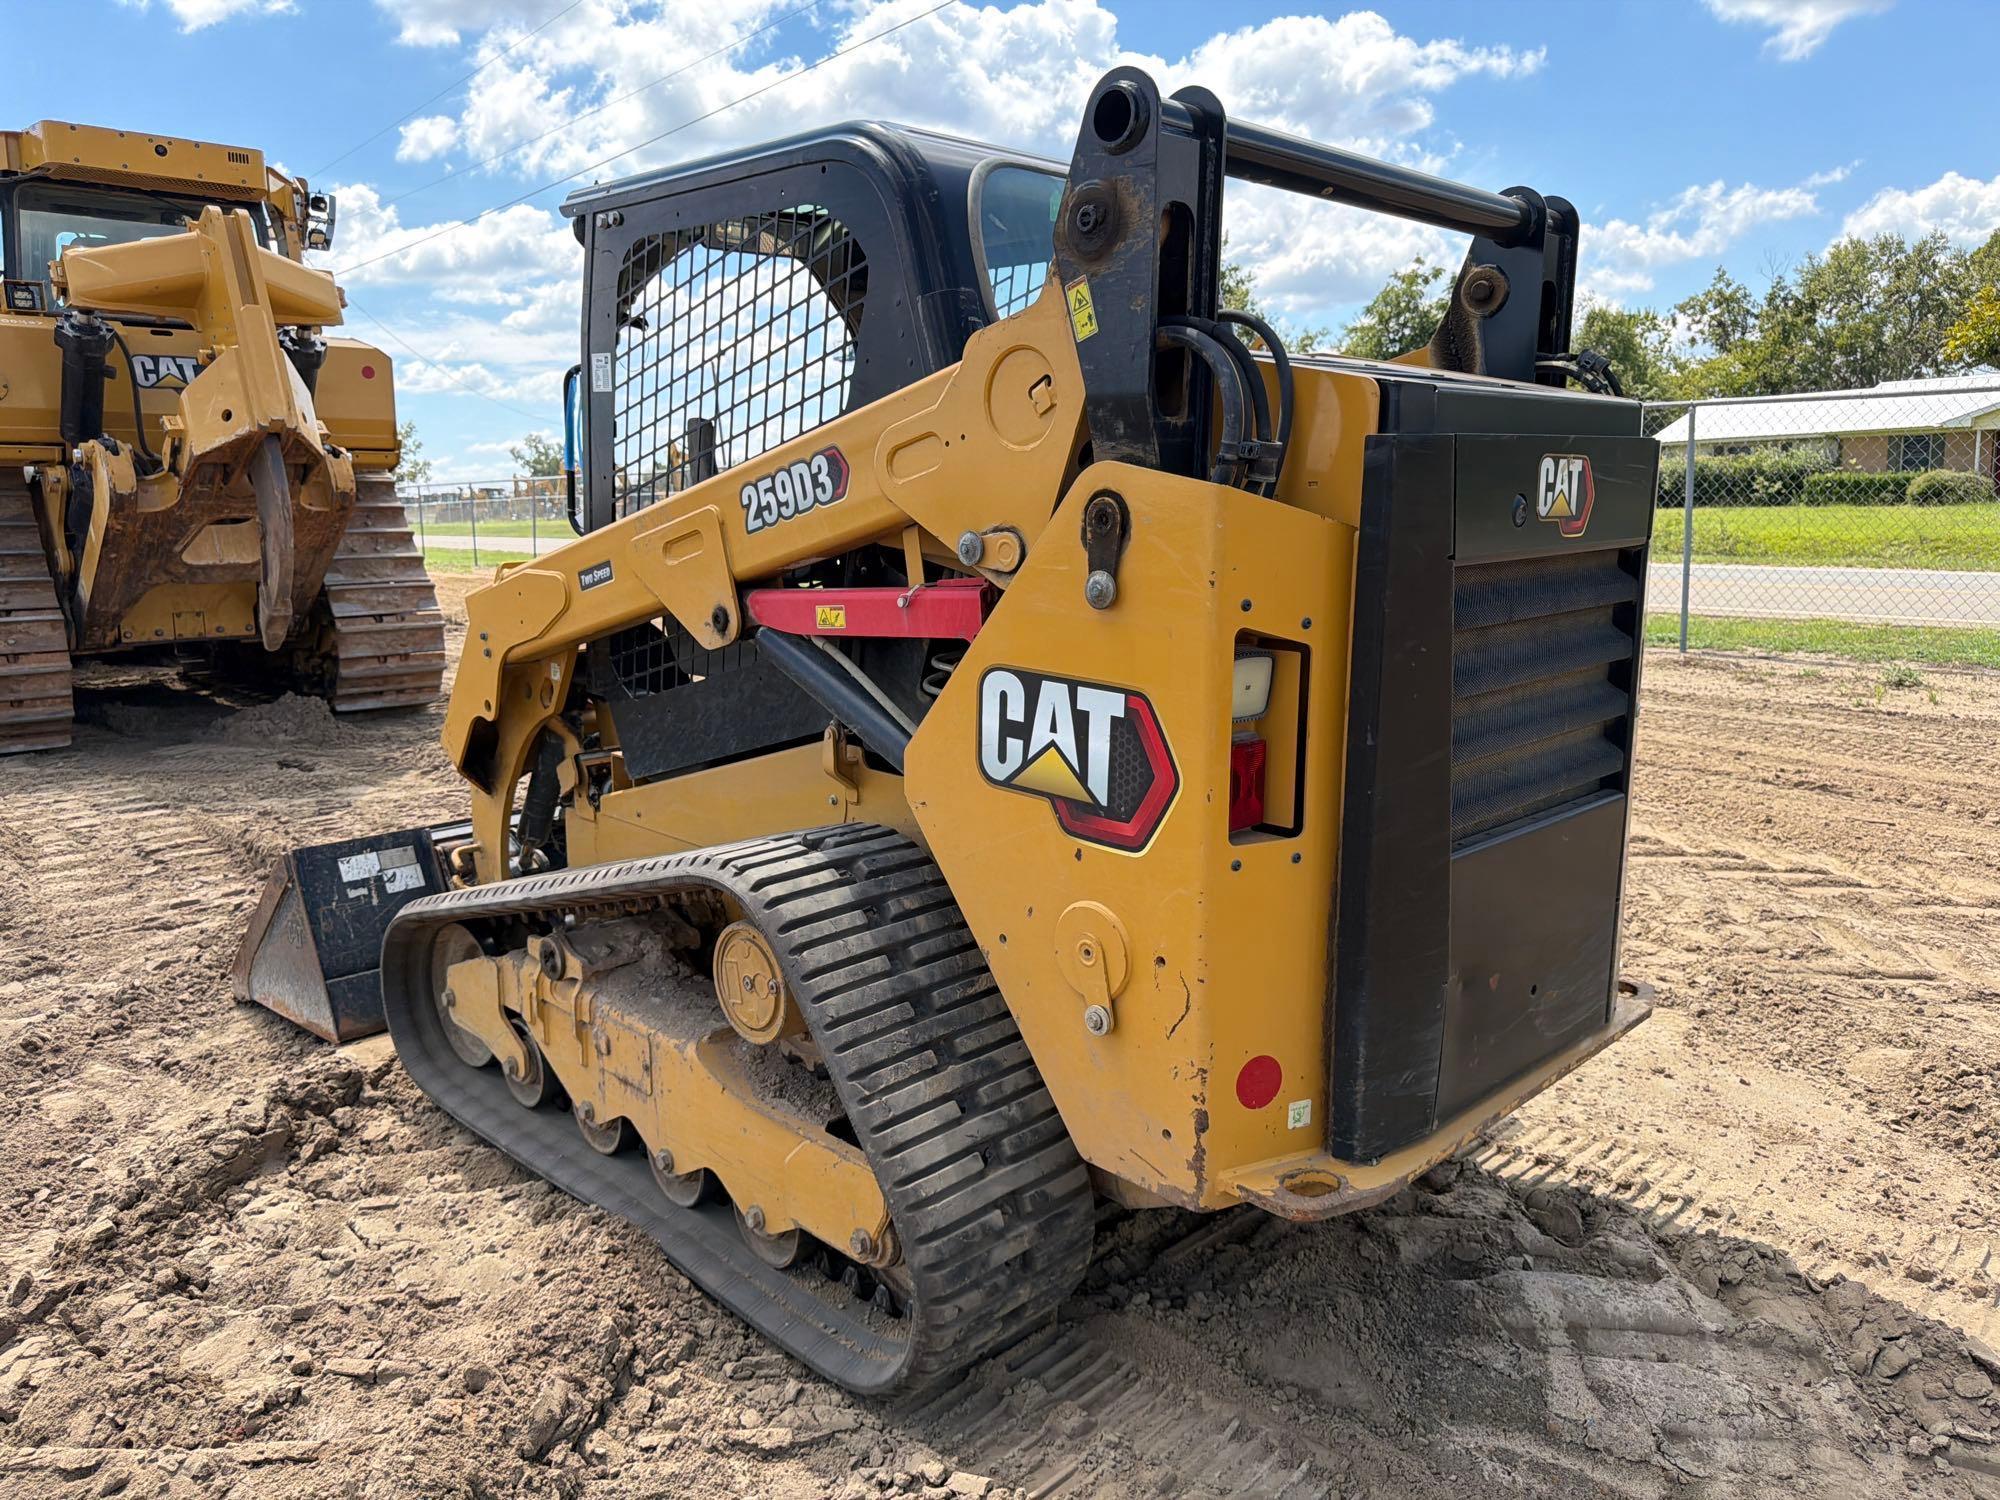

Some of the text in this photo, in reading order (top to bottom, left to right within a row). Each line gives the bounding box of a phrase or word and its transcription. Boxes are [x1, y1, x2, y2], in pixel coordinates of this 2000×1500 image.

[132, 356, 198, 387] CAT
[741, 455, 834, 531] 259D3
[1539, 457, 1583, 517] CAT
[982, 670, 1125, 807] CAT
